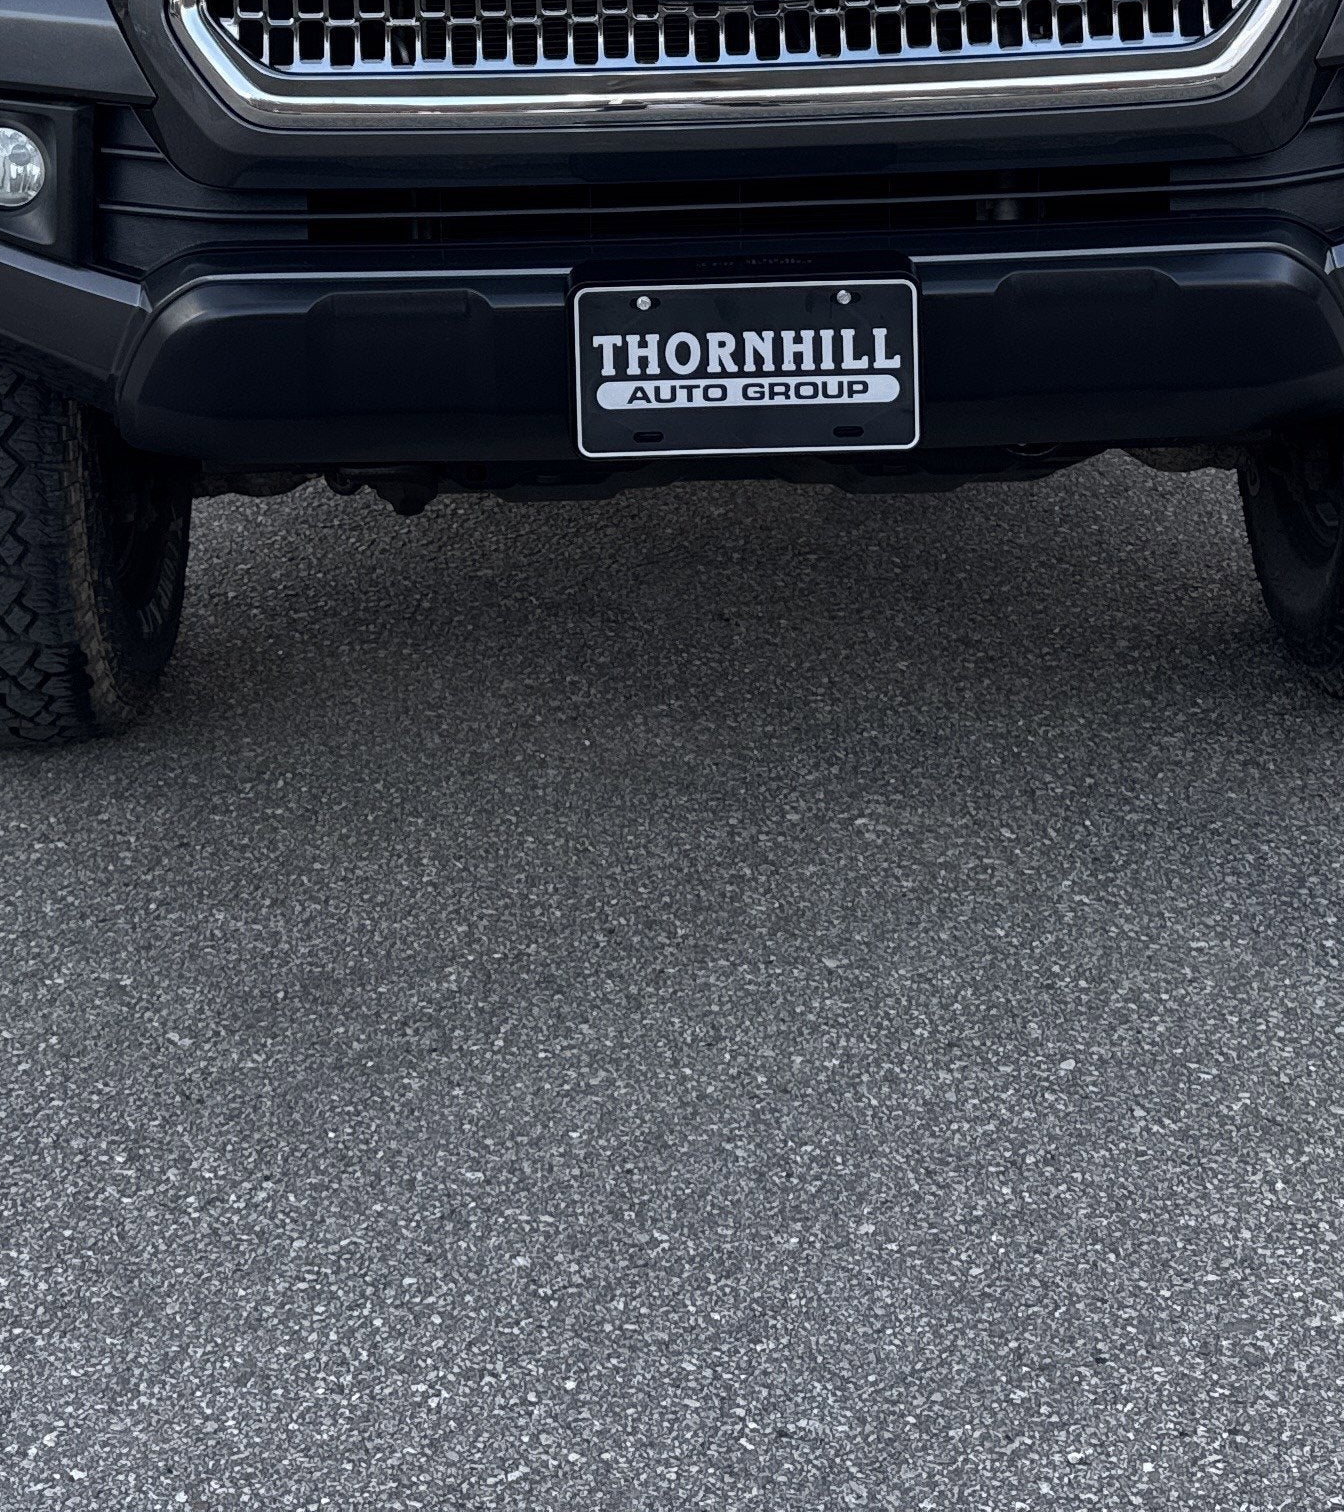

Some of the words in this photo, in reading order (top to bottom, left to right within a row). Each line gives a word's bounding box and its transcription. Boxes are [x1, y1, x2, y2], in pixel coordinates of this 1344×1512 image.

[592, 327, 902, 377] THORNHILL
[626, 383, 729, 405] AUTO
[741, 379, 870, 401] GROUP
